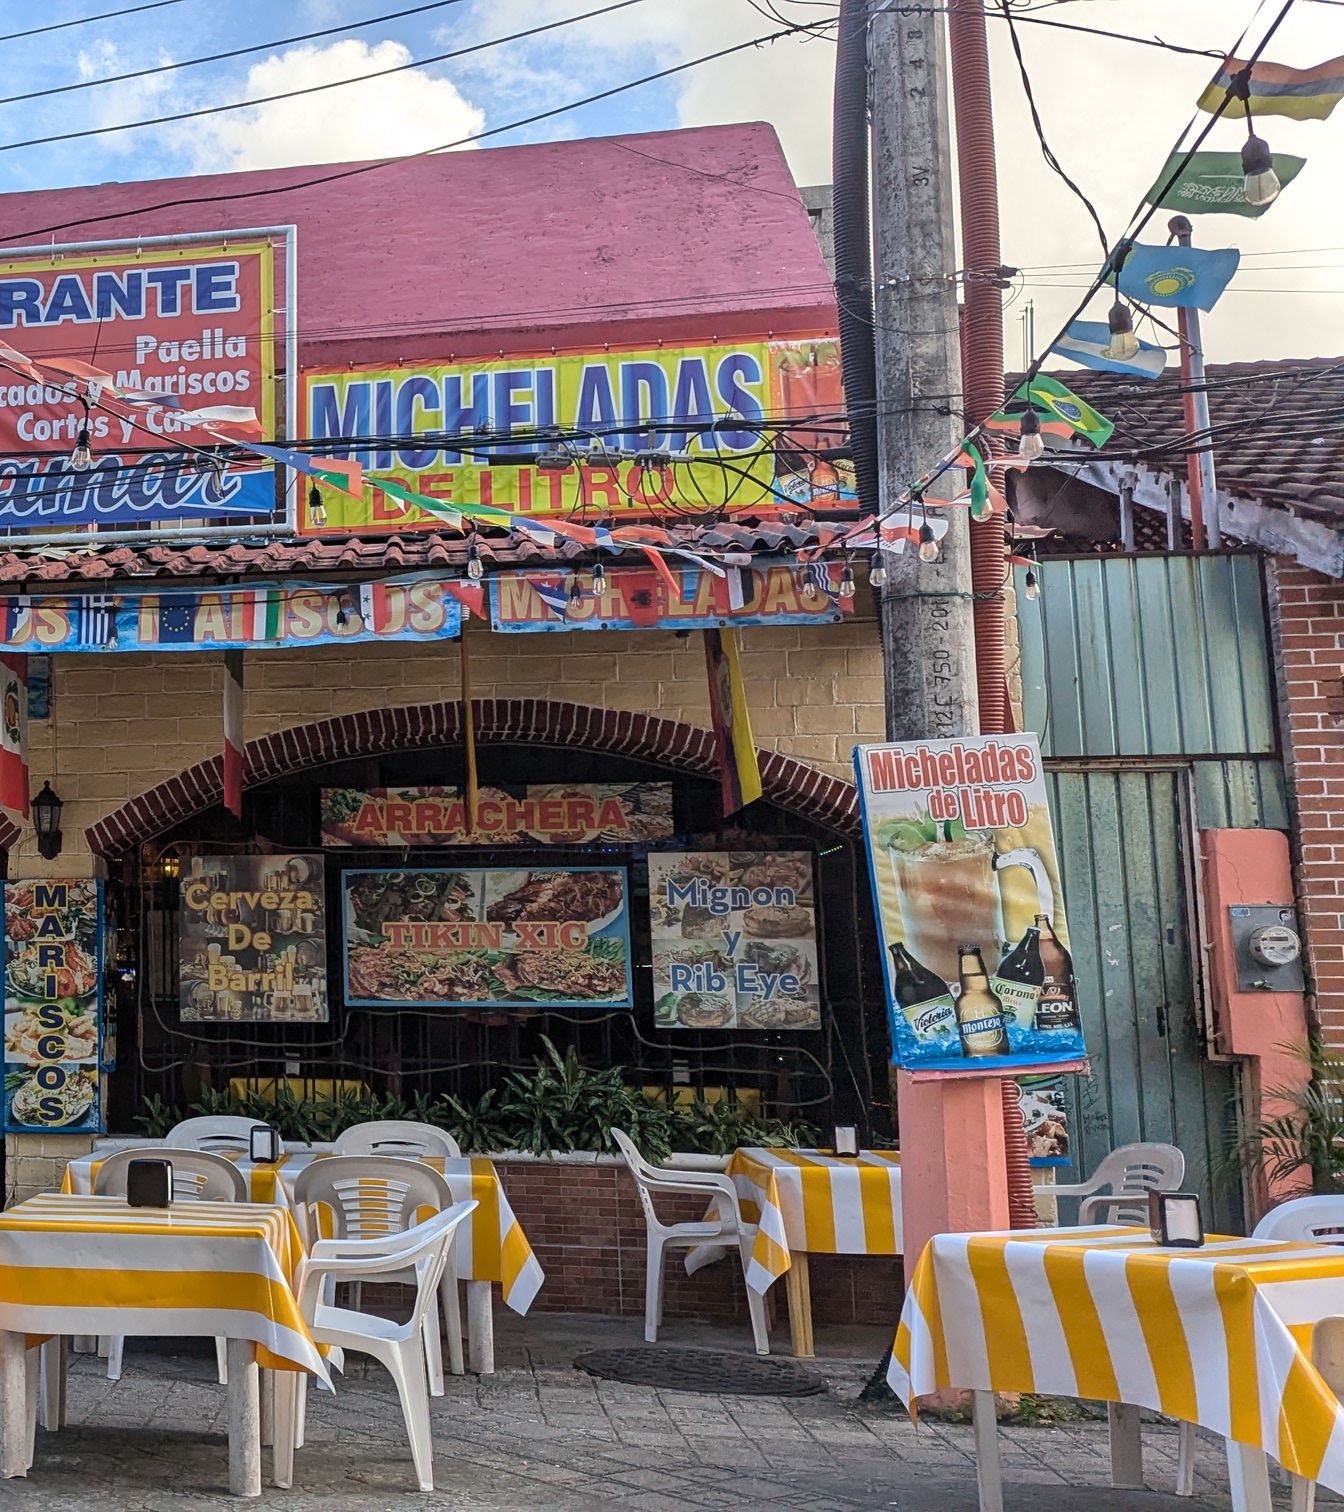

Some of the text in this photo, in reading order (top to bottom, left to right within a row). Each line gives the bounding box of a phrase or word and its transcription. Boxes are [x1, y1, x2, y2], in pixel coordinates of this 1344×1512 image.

[135, 328, 248, 365] Paella
[115, 366, 251, 398] Mariscos
[16, 411, 109, 442] Cortes
[118, 414, 138, 444] y
[309, 351, 764, 473] MICHELADAS
[372, 464, 675, 521] DE LITRO
[867, 740, 1036, 794] Micheladas
[353, 798, 629, 834] ARRACHERA
[927, 784, 1030, 831] de Litro
[185, 883, 314, 911] Cerveza
[666, 877, 796, 916] Mignon
[228, 924, 273, 951] De
[382, 920, 589, 951] TIKIN XIC
[722, 930, 742, 957] y
[208, 962, 294, 992] Barril
[669, 962, 800, 1000] Rib Eye
[995, 983, 1036, 1000] Corona
[33, 882, 69, 1125] MARISCOS
[913, 1005, 954, 1033] Victoria
[1036, 1001, 1074, 1014] LEON
[962, 1017, 1002, 1035] Montejo
